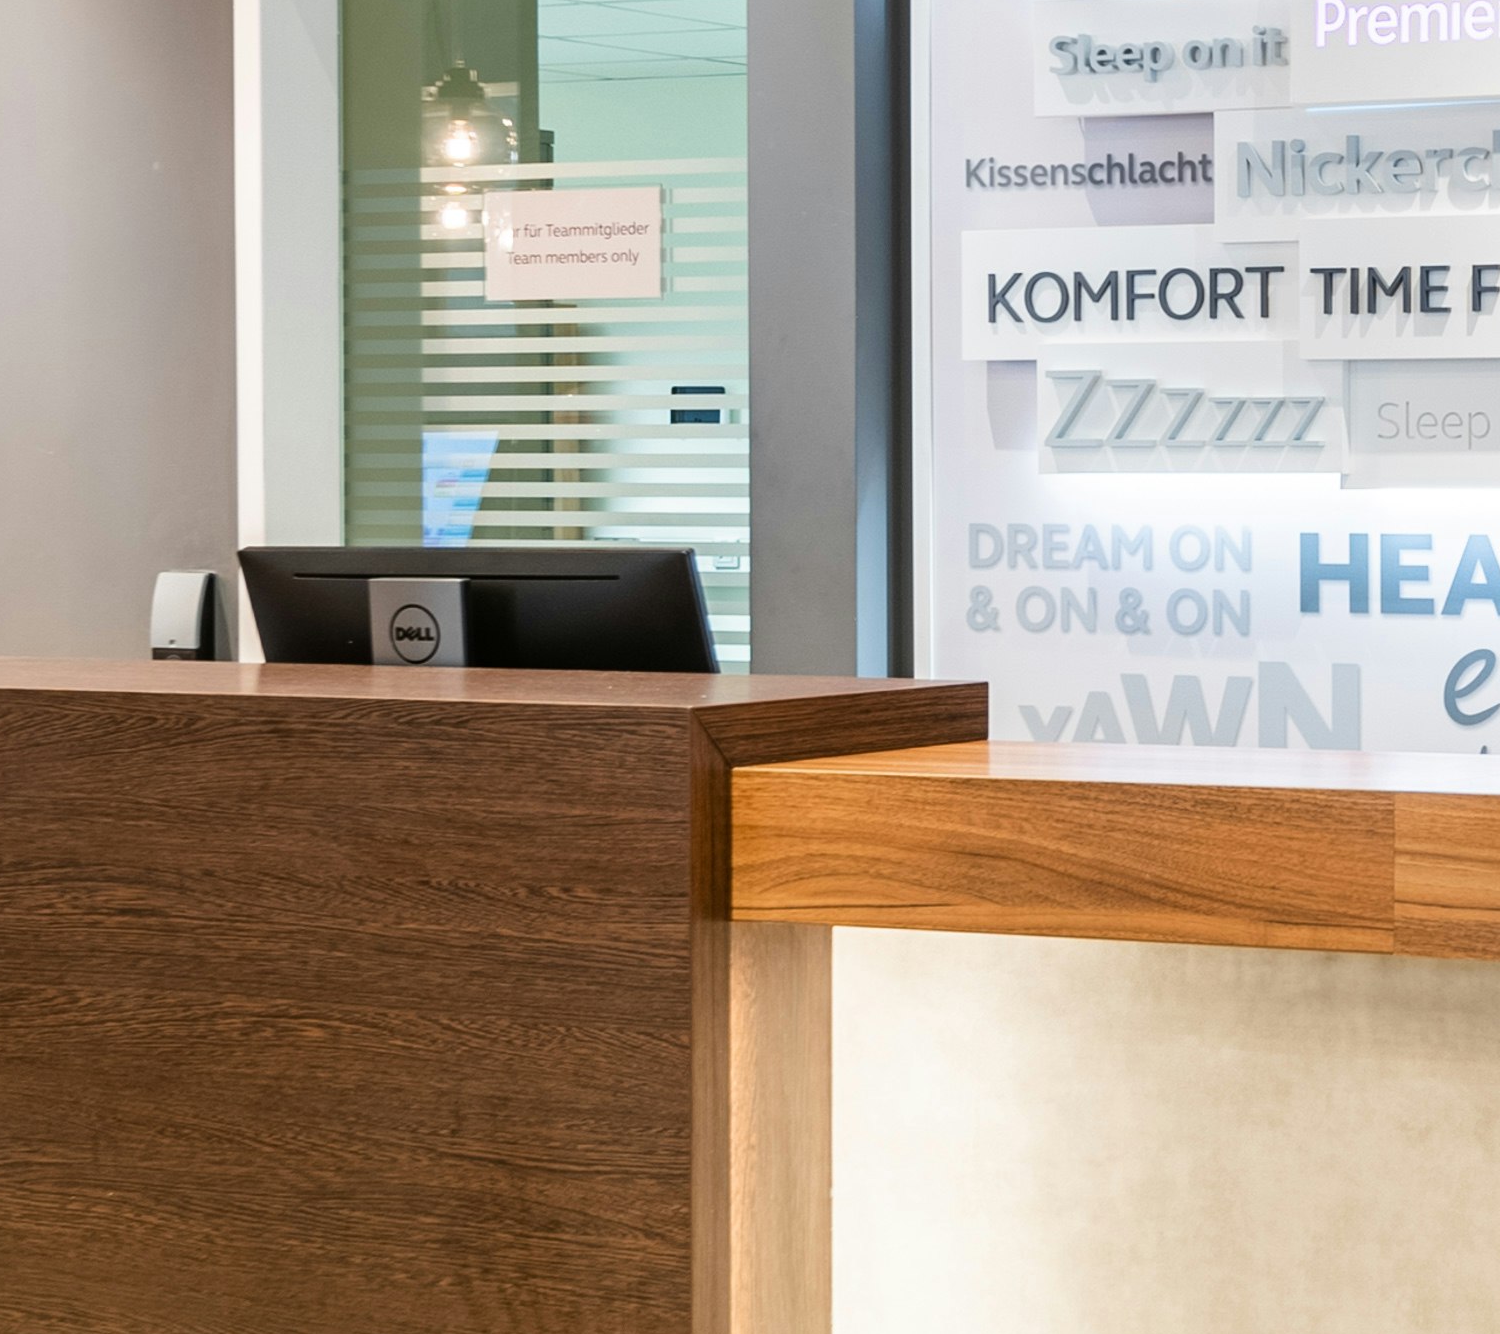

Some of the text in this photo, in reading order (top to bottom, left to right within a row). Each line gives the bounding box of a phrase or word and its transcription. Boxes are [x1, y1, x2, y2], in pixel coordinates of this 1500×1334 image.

[1048, 26, 1290, 82] Sleep on it
[964, 149, 1213, 190] Kissenschlacht
[524, 224, 542, 238] für
[546, 222, 649, 239] Teammitglieder
[507, 249, 639, 265] Team members only
[986, 266, 1286, 324] KOMFORT
[1310, 264, 1451, 317] TIME
[1375, 400, 1492, 452] Sleep
[967, 522, 1252, 574] DREAM ON
[395, 626, 434, 641] DELL
[965, 586, 1251, 636] & ON & ON
